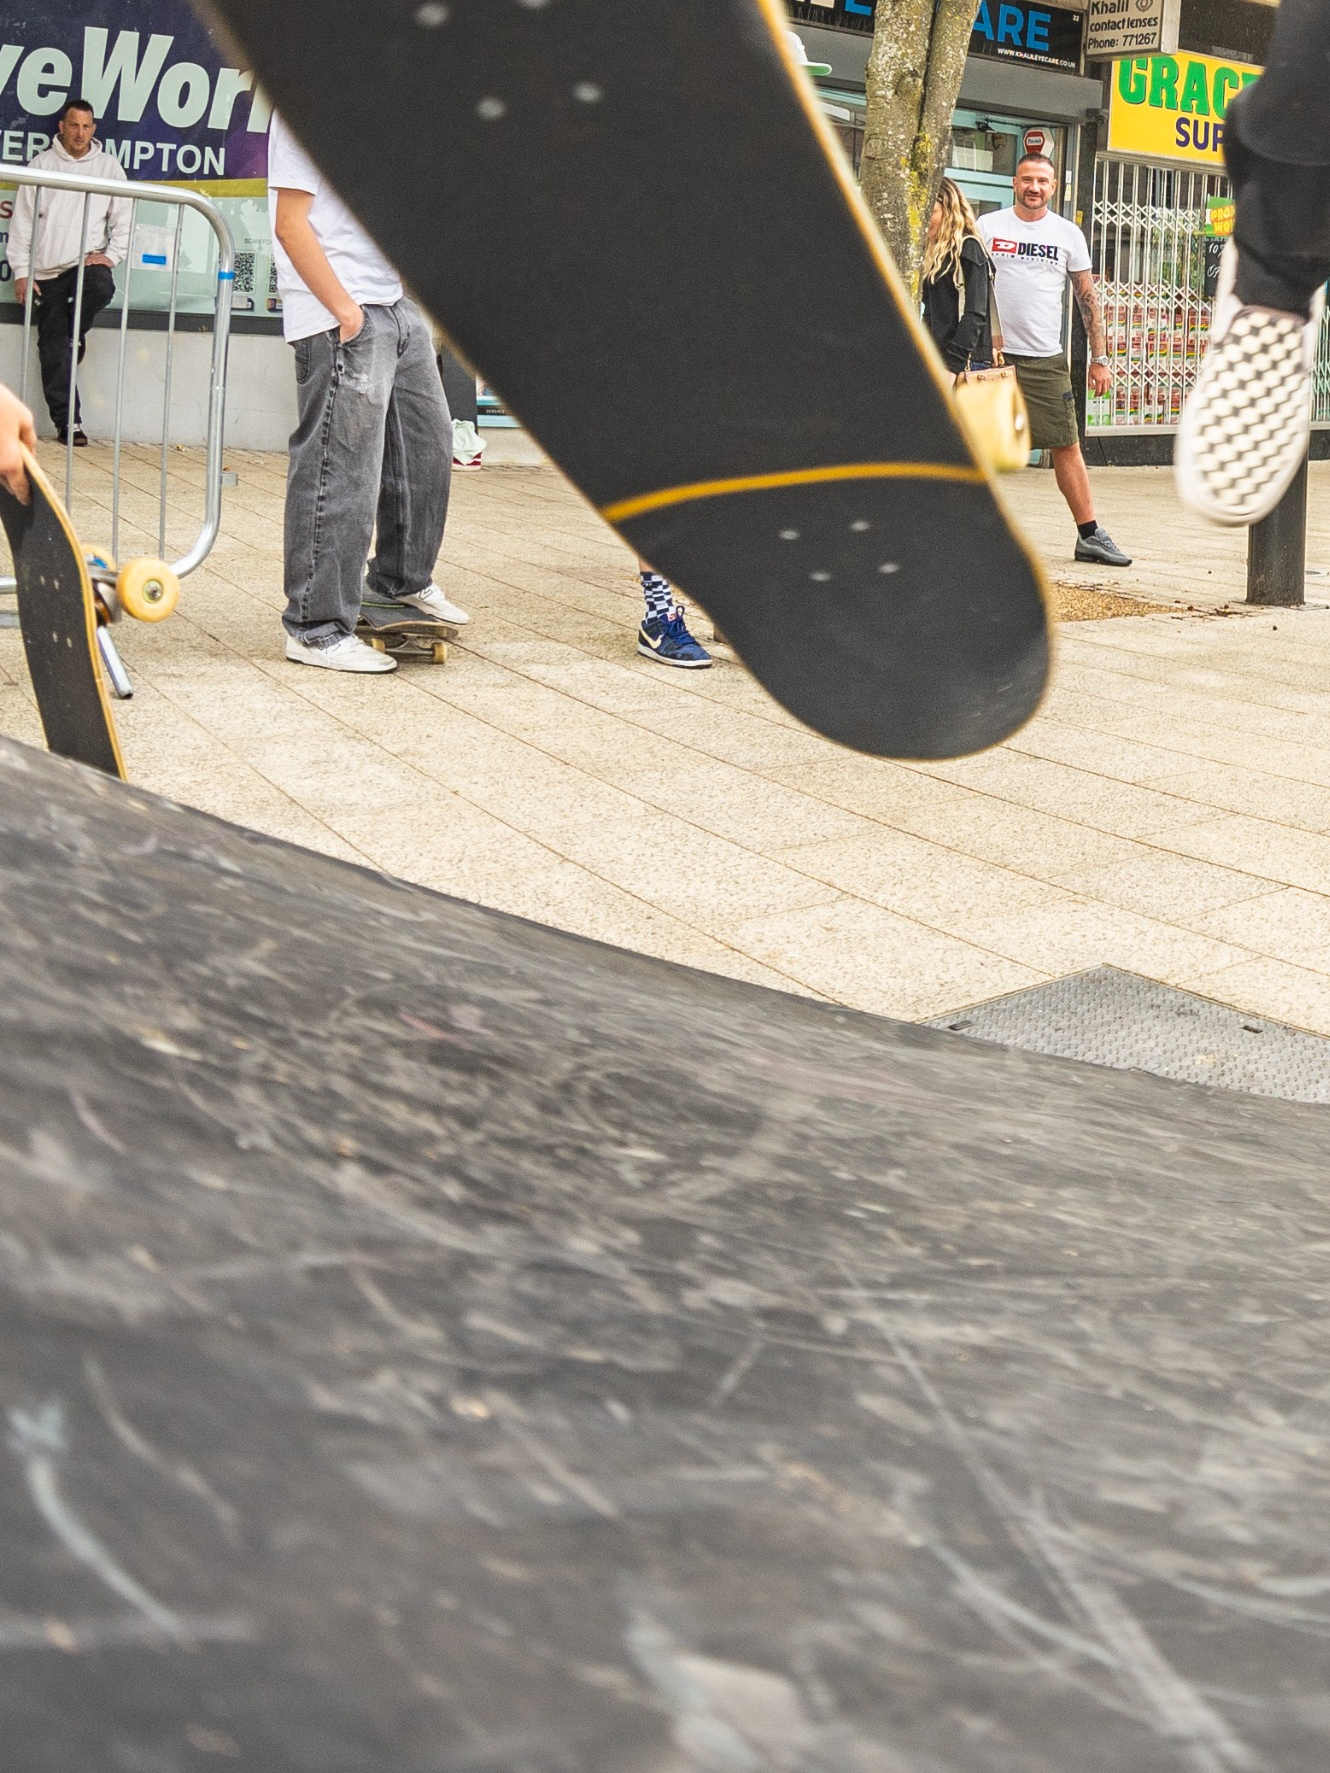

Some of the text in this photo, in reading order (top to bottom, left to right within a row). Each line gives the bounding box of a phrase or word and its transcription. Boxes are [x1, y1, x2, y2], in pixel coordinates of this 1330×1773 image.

[1089, 16, 1159, 32] contact lenses
[1087, 32, 1157, 49] Phone: 771267
[1175, 116, 1226, 152] SUP
[0, 129, 226, 176] ERMPTON
[1018, 242, 1059, 261] DIESEL
